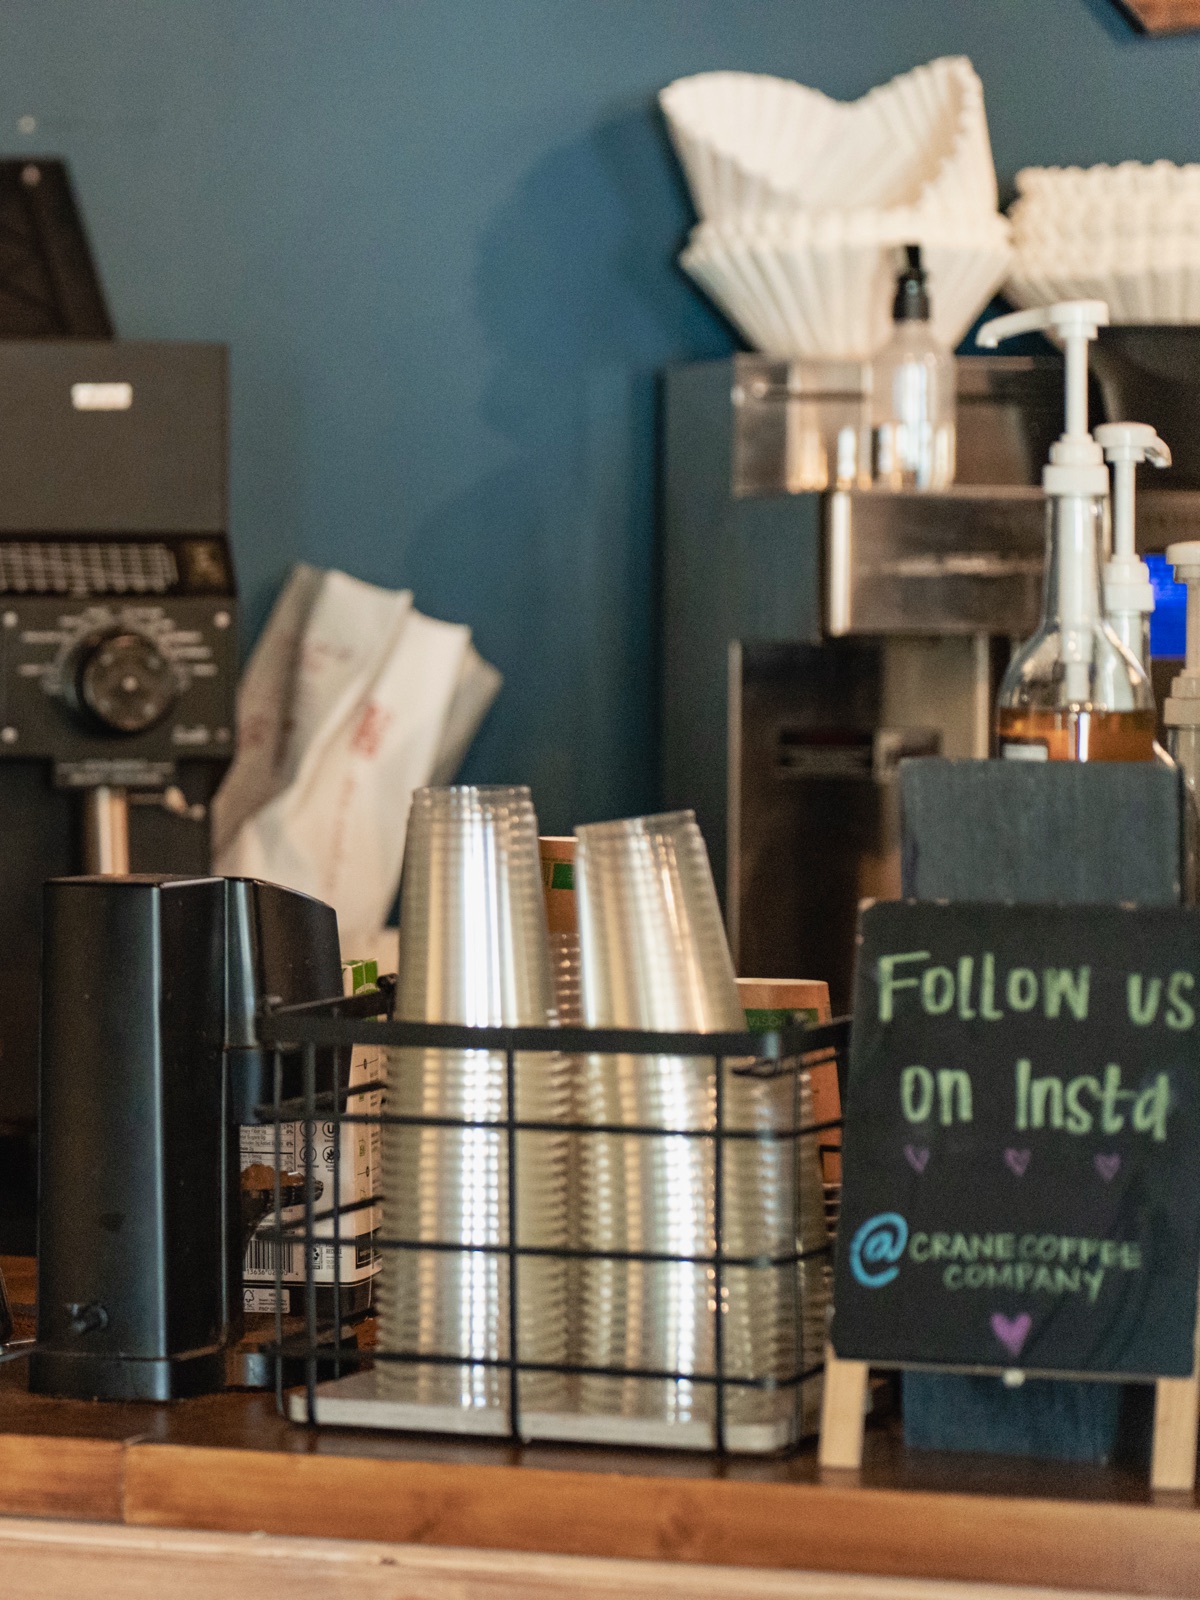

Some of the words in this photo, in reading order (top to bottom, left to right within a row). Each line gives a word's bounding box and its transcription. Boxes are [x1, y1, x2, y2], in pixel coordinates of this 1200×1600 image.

[1126, 970, 1196, 1030] us
[901, 1065, 973, 1126] on
[1015, 1057, 1171, 1142] Insta
[943, 1262, 1104, 1303] COMPANY
